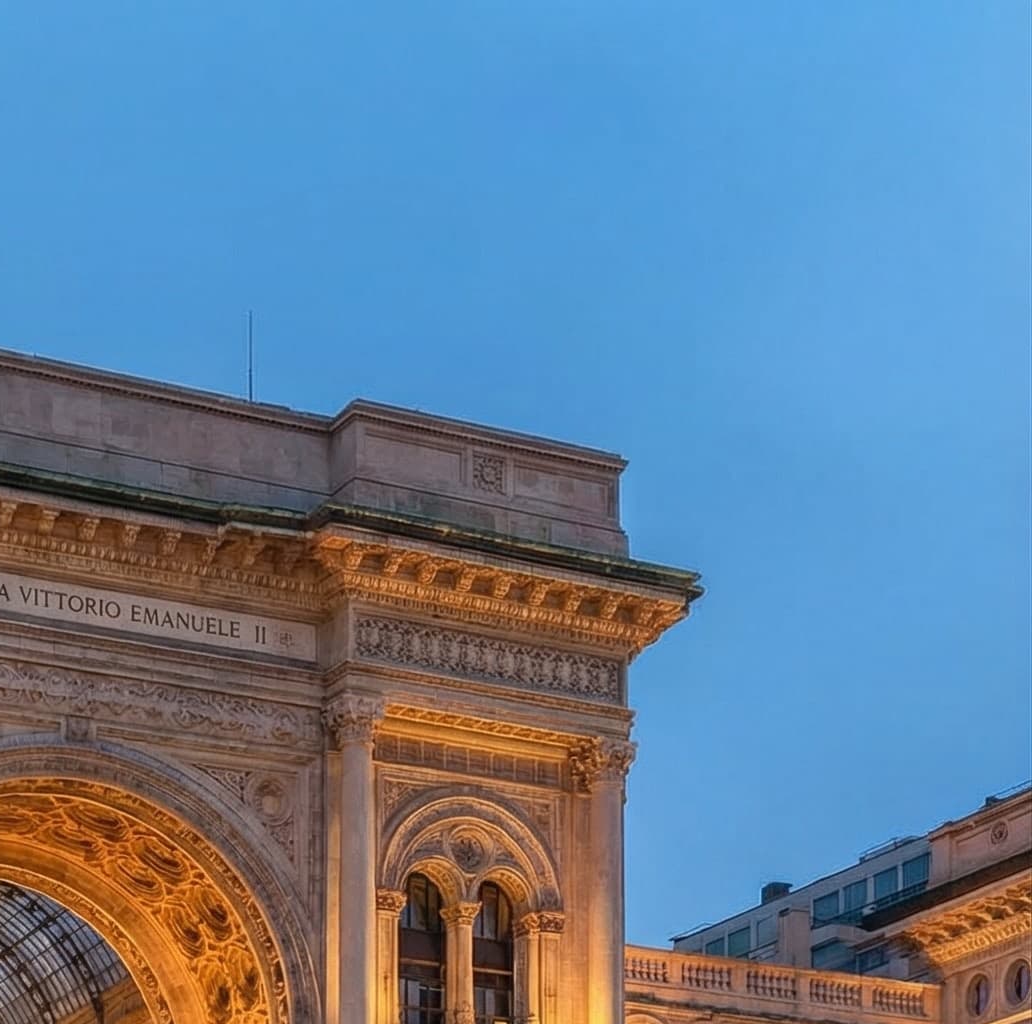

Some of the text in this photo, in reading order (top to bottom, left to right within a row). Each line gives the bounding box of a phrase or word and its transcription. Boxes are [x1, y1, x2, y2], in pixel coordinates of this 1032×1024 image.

[19, 587, 121, 618] VITTORIO
[131, 606, 240, 638] EMANUELE
[255, 626, 267, 645] II
